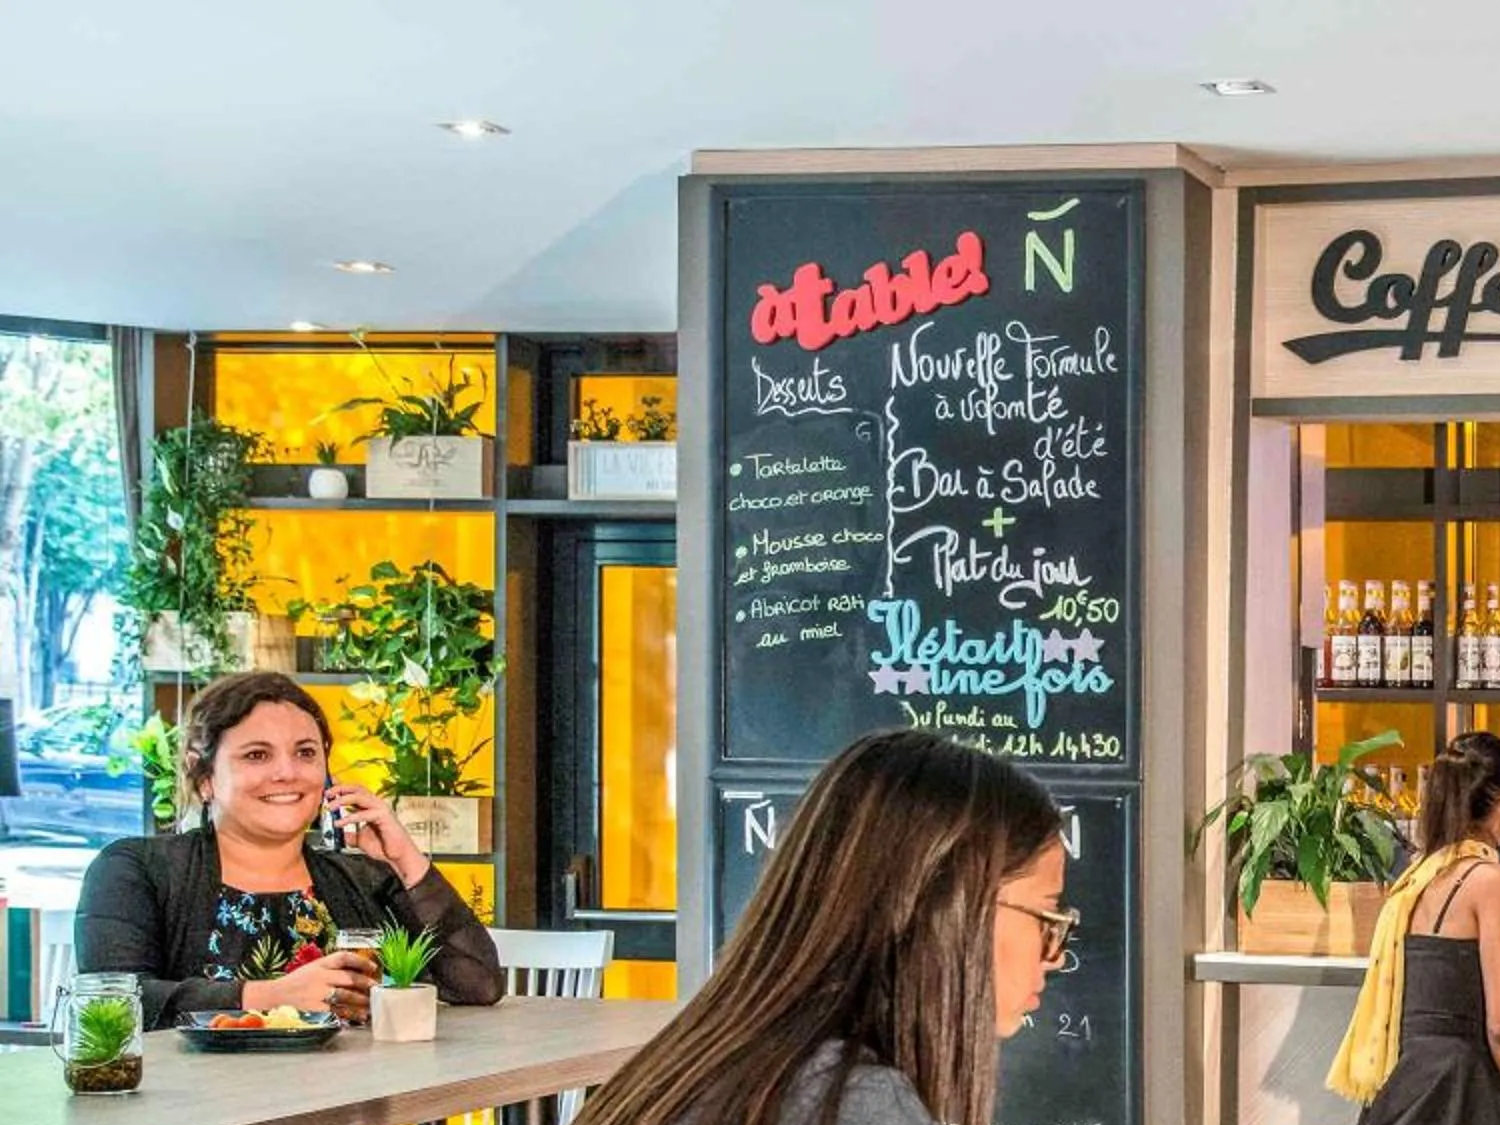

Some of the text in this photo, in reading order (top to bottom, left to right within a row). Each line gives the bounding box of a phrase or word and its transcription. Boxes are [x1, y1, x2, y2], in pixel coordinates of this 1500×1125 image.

[892, 320, 1119, 389] Nouvelle Formule
[752, 356, 847, 412] Desserts
[936, 382, 1068, 434] à volonté
[1034, 416, 1108, 460] d'été
[891, 447, 1101, 512] Bar à Salade
[753, 528, 884, 555] Mousse choco
[893, 525, 1092, 609] Plat du jour
[756, 622, 843, 648] au miel
[935, 700, 985, 729] lundi
[991, 712, 1018, 729] au
[1056, 1013, 1091, 1040] 21
